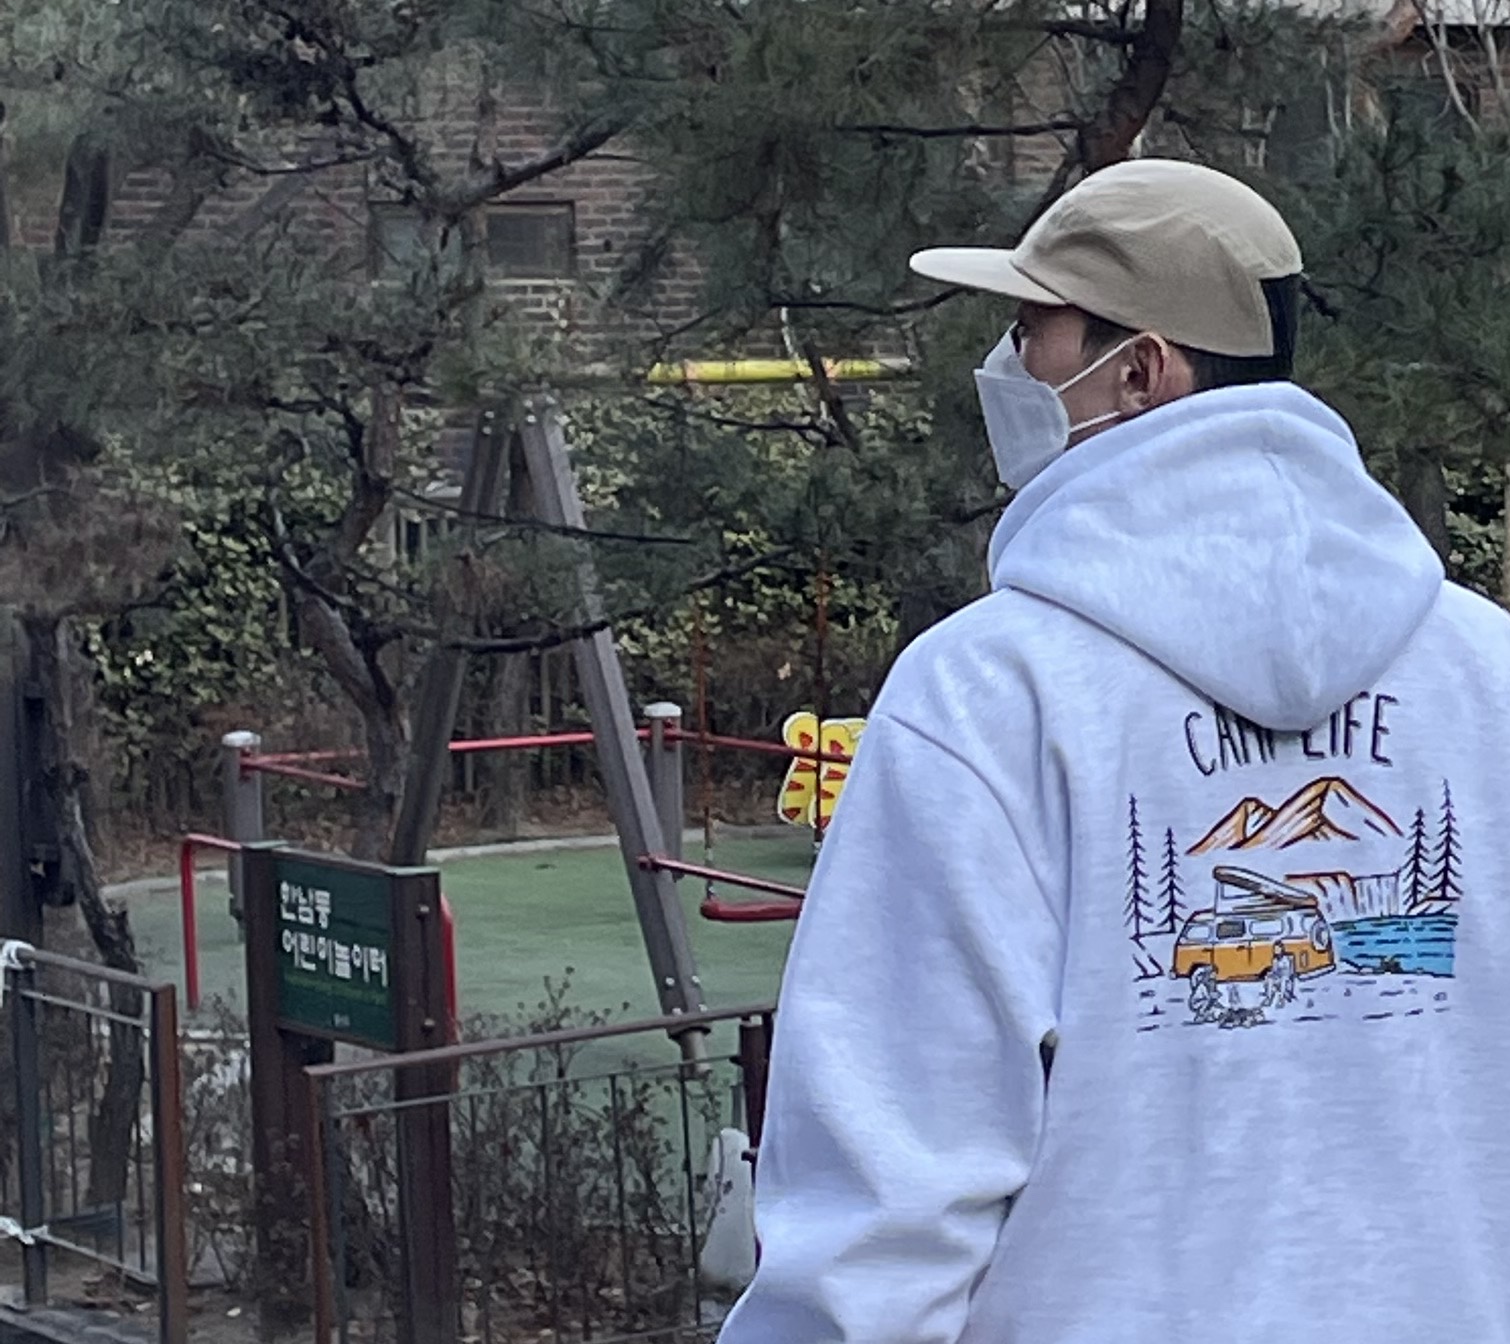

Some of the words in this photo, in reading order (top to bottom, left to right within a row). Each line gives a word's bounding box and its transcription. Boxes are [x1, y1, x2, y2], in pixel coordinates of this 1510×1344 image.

[1300, 691, 1399, 767] LIFE
[280, 879, 332, 929] 한남동
[281, 928, 390, 988] 어린이놀이터
